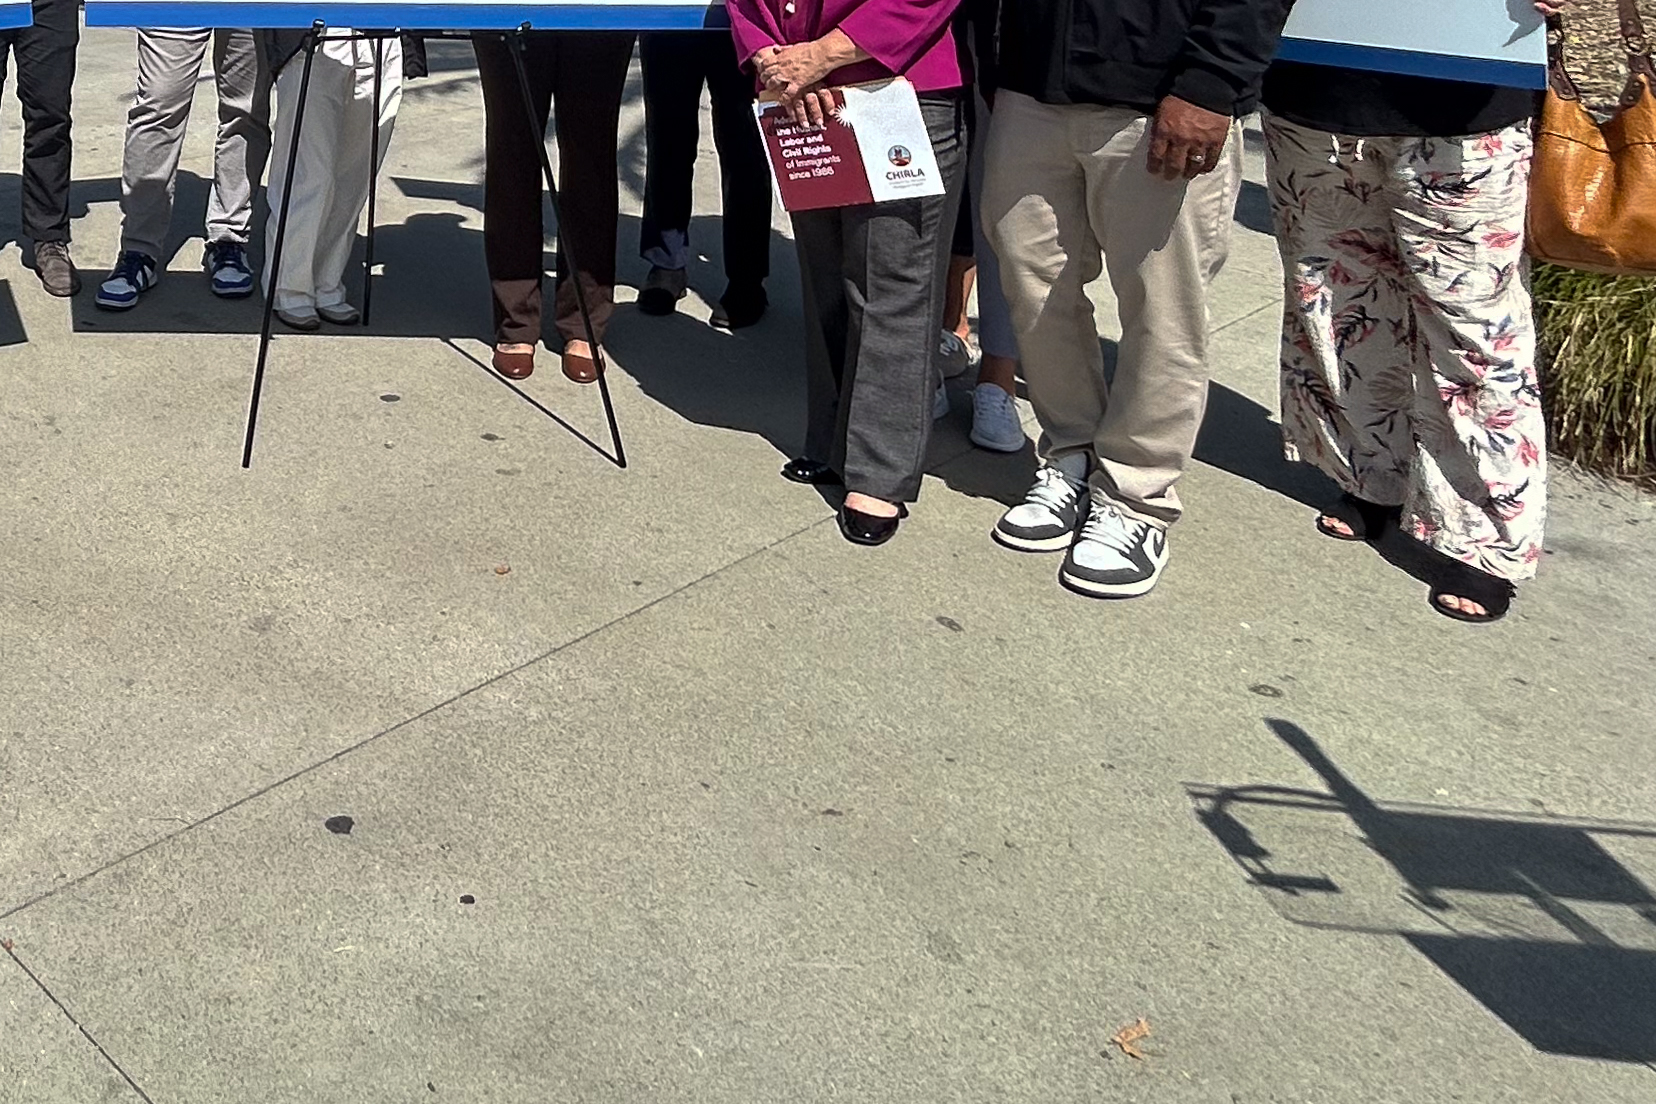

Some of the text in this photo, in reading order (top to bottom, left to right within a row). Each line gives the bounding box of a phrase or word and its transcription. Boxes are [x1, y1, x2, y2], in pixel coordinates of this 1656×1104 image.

[779, 134, 823, 147] Labor and
[803, 145, 832, 156] Rights
[885, 168, 925, 180] CHIRLA
